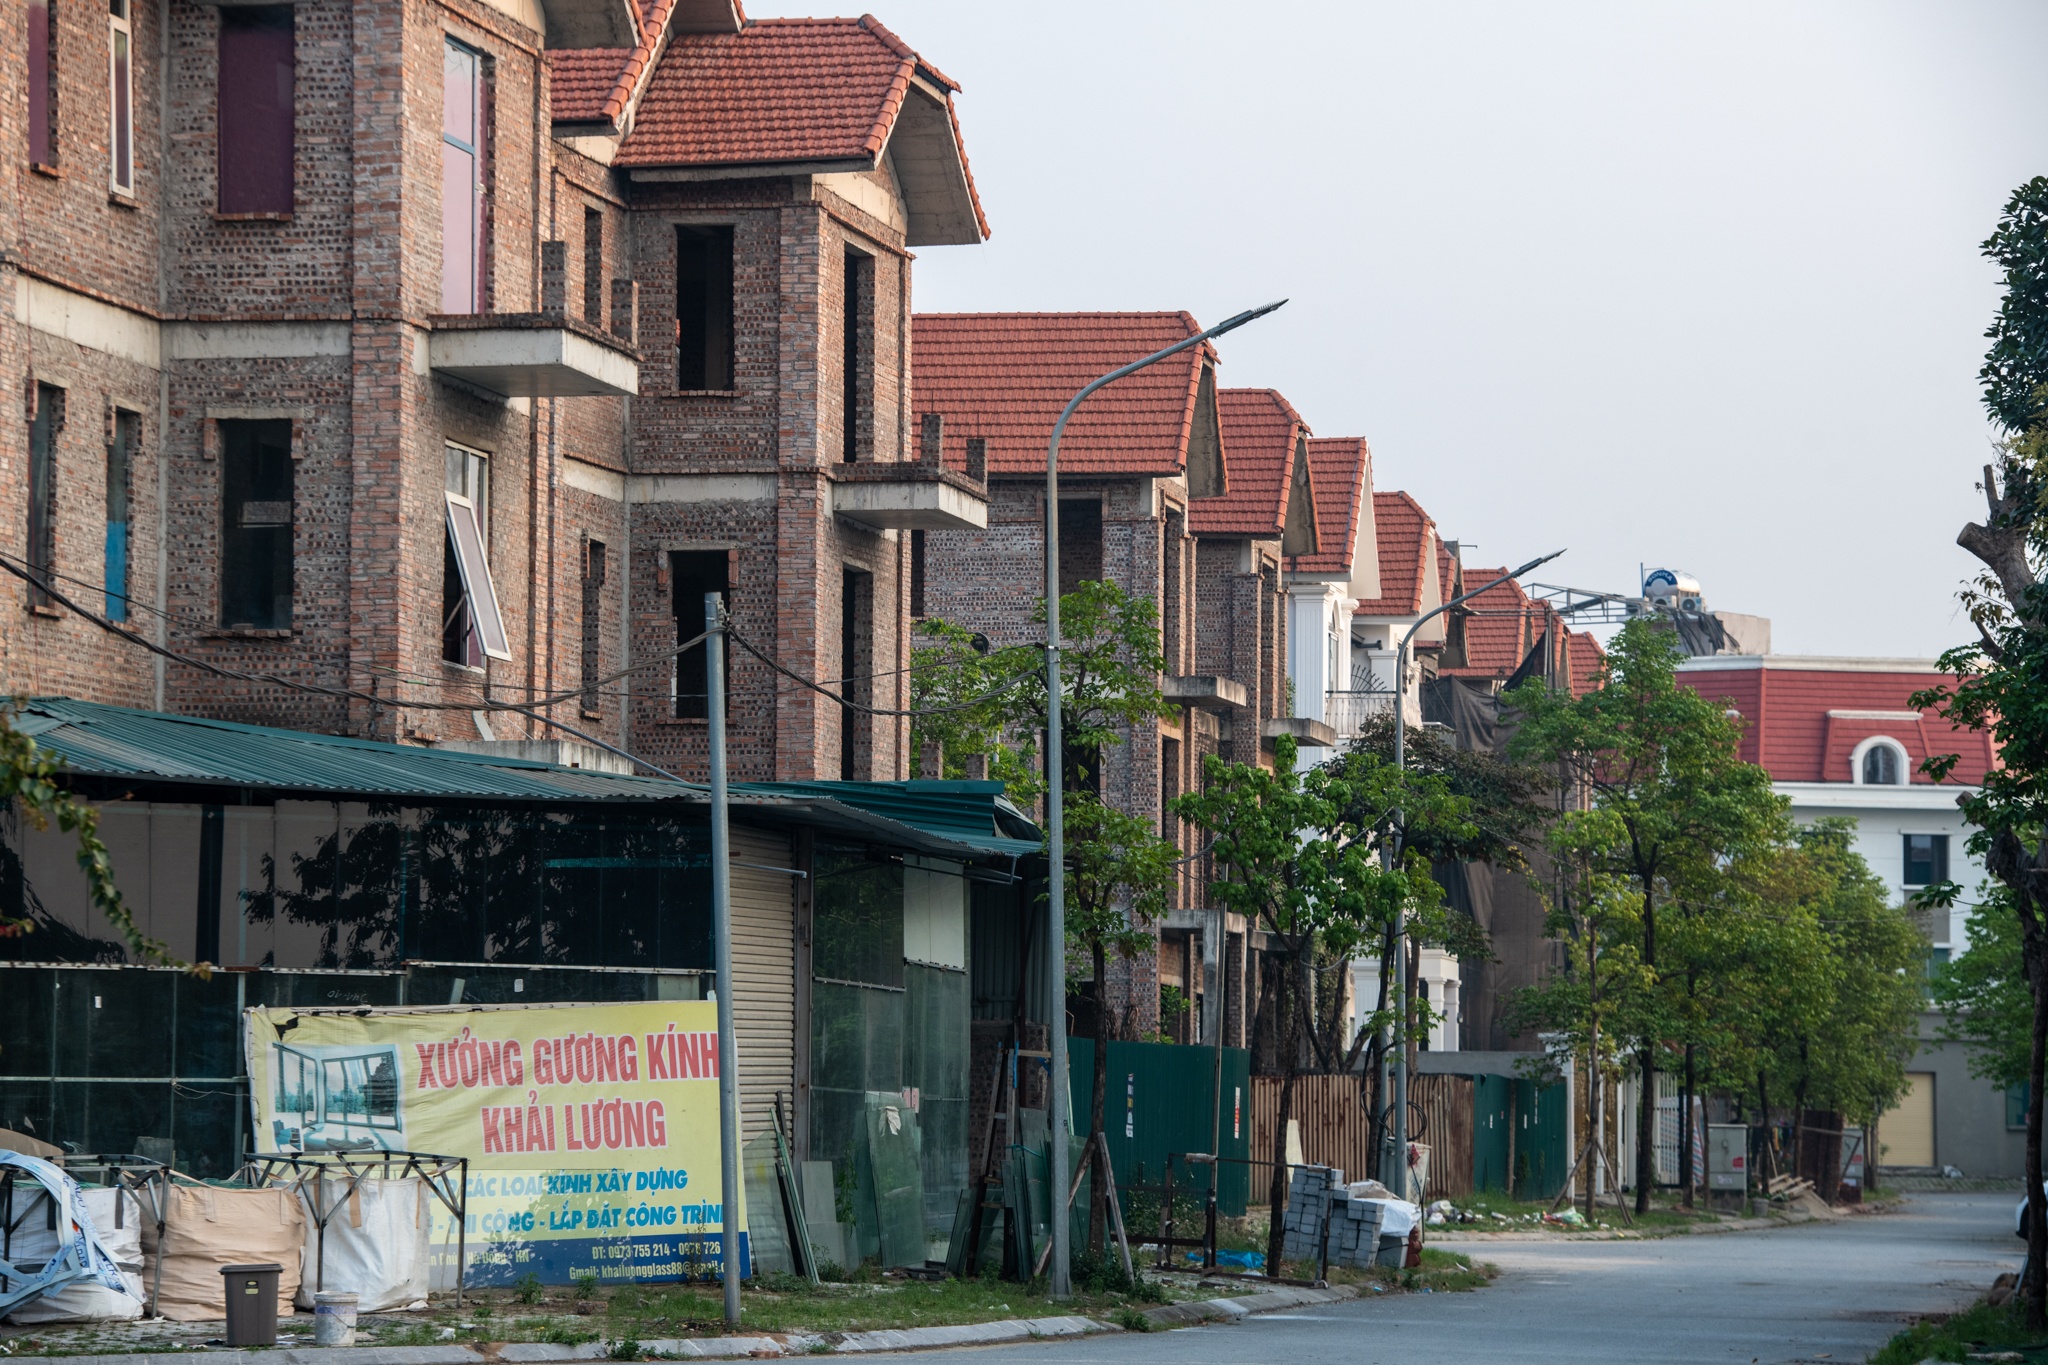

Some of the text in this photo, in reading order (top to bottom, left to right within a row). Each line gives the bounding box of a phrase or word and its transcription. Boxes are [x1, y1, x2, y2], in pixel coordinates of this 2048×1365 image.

[415, 1023, 719, 1088] XƯỞNG GƯƠNG KÍNH
[482, 1090, 666, 1153] KHẢI LƯƠNG
[501, 1176, 543, 1201] LOẠI
[548, 1169, 592, 1194] KÍNH
[595, 1168, 632, 1192] XÂY
[636, 1166, 688, 1196] DỰNG
[481, 1208, 535, 1233] CÔNG
[550, 1200, 583, 1231] LẮP
[586, 1202, 622, 1234] ĐẶT
[625, 1201, 677, 1227] CÔNG
[681, 1198, 723, 1224] TRÌN
[592, 1246, 606, 1260] ĐT:
[608, 1244, 632, 1259] 0973
[633, 1243, 651, 1258] 755
[653, 1242, 670, 1257] 214
[703, 1240, 721, 1255] 726
[569, 1265, 600, 1280] Gmail:
